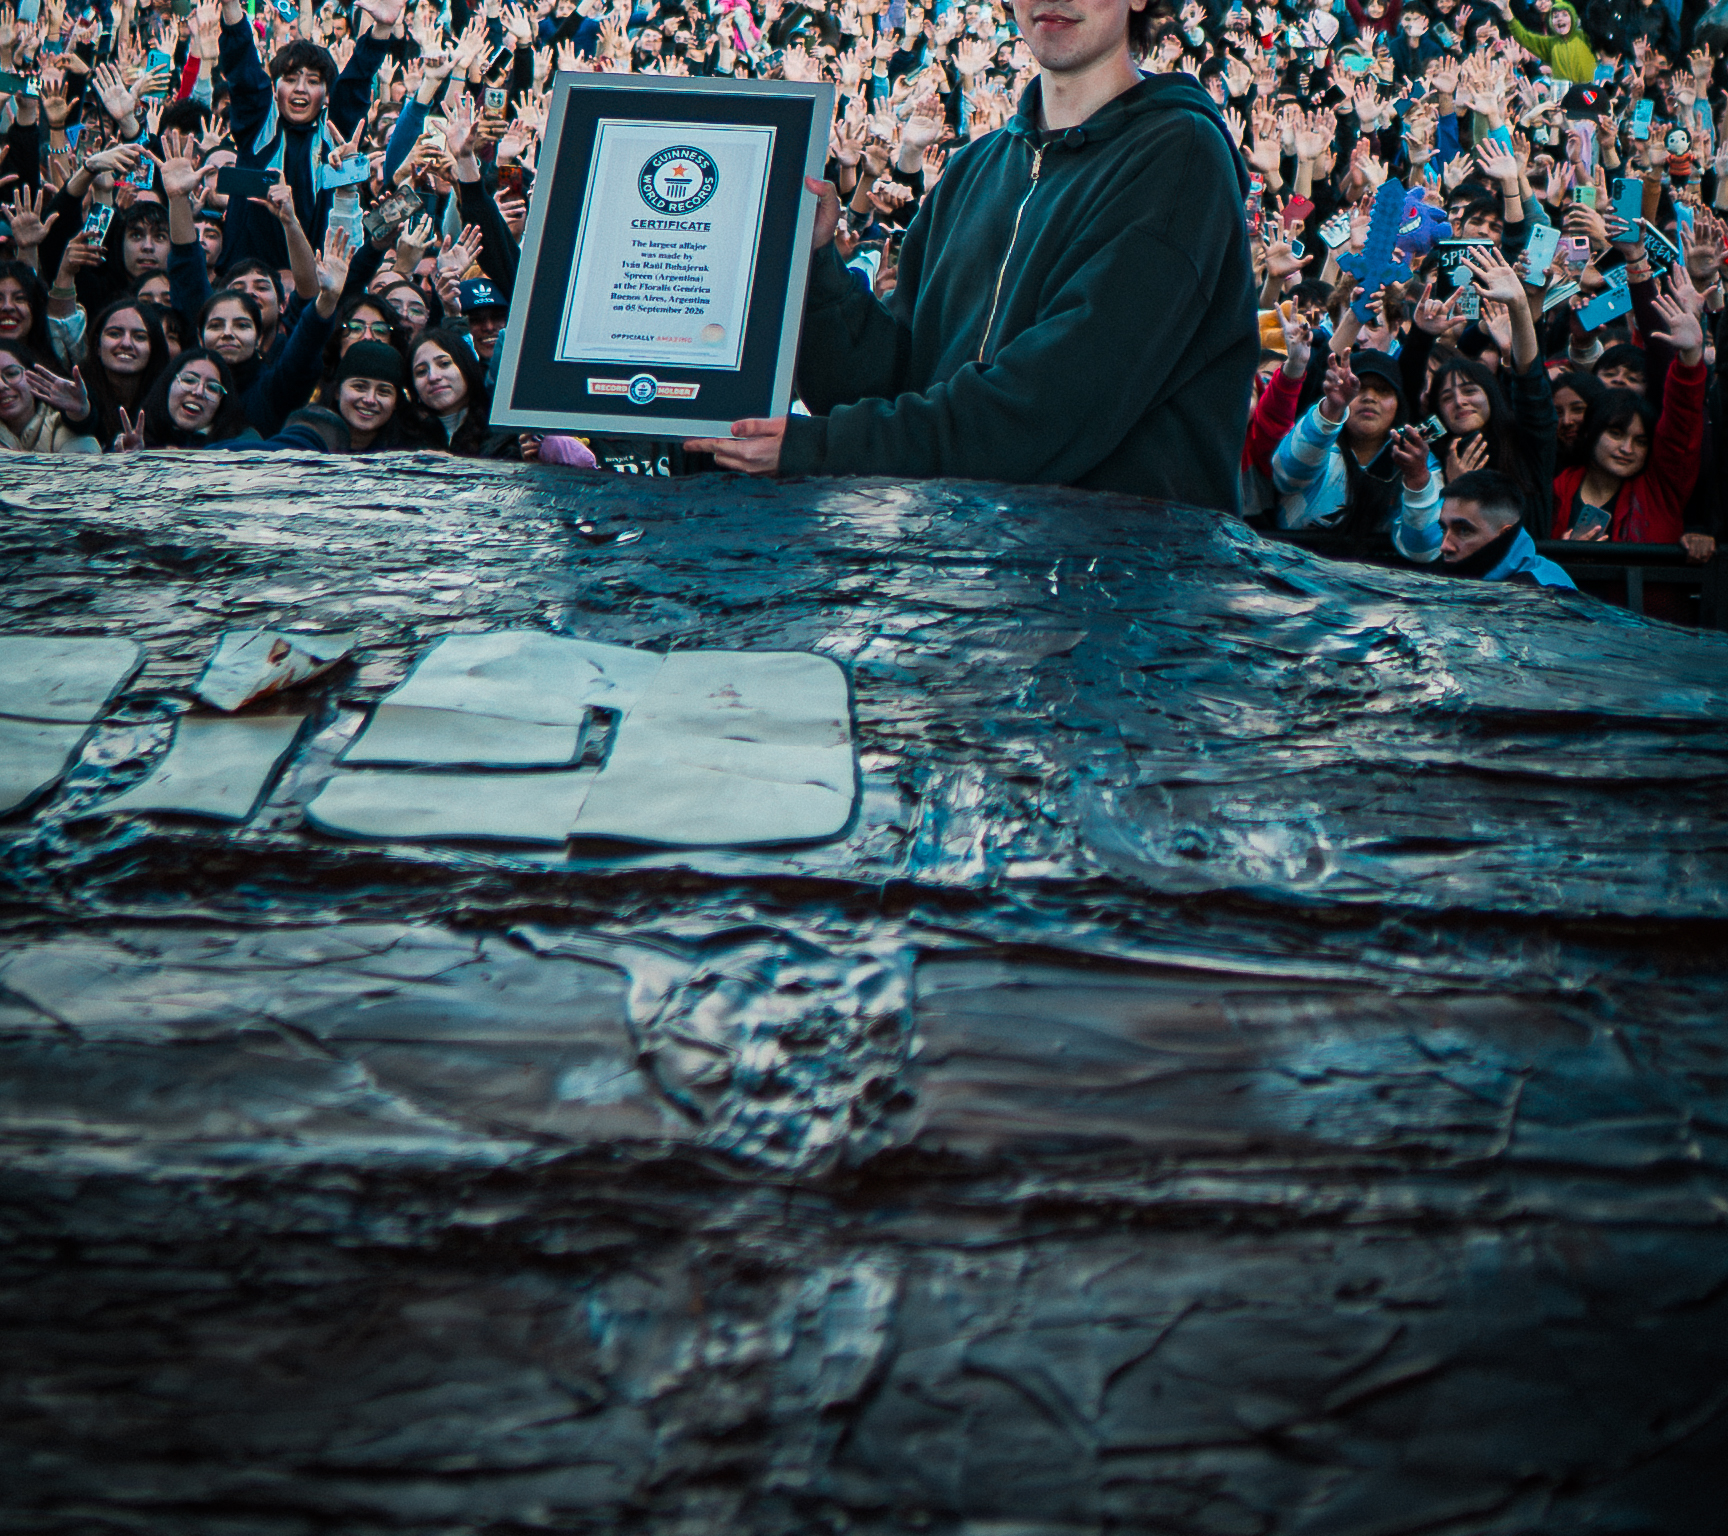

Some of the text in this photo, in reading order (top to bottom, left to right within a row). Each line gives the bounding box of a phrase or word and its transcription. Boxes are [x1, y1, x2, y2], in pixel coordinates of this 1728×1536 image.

[653, 150, 710, 169] GUINNESS
[643, 175, 714, 211] WORLD RECORDS
[631, 219, 711, 231] CERTIFICATE
[632, 239, 707, 251] The largest alfajor
[683, 252, 693, 262] by
[643, 261, 663, 269] Raúl
[624, 272, 704, 283] Spreen (Argentina)
[624, 282, 637, 290] the
[639, 283, 671, 292] Floralis
[610, 292, 710, 305] Buenos Aires, Argentina
[637, 305, 682, 314] September
[684, 306, 705, 315] 2026
[611, 333, 655, 341] OFFICIALLY
[595, 384, 628, 392] RECORD
